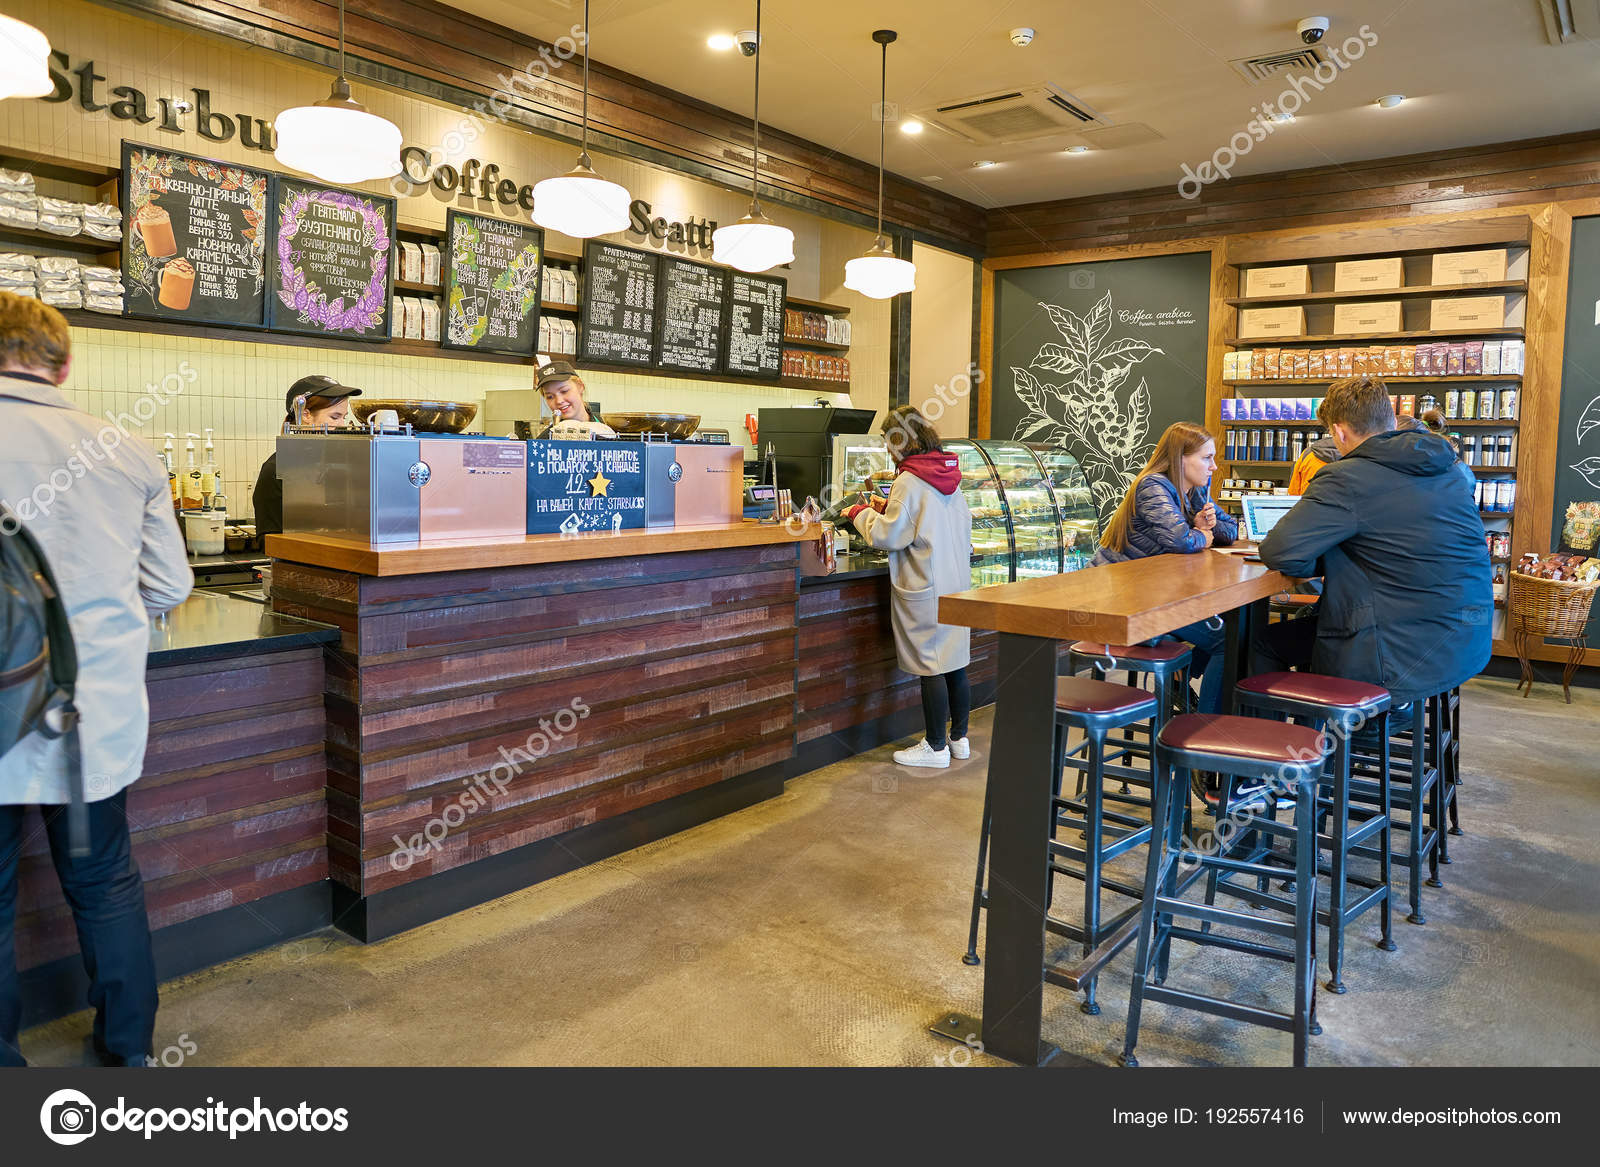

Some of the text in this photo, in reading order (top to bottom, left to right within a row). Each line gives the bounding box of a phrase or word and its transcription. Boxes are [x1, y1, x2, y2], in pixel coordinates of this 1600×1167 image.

[190, 195, 220, 211] ЛАТТЕ
[400, 146, 534, 210] Coffee
[629, 199, 718, 250] Seattl
[215, 211, 230, 221] 300
[217, 219, 232, 231] 315
[473, 217, 523, 239] ЛИМОНАДЫ
[189, 226, 234, 241] ВЕНТИ 330
[198, 237, 241, 256] НОВИНКА
[489, 245, 504, 258] АЙС
[506, 248, 517, 261] ТИ
[196, 261, 248, 279] ПЕКАН ЛАТТЕ
[476, 254, 508, 270] ЛИМОНАД
[1117, 307, 1193, 325] Coffea arabica
[547, 449, 639, 462] МЫ ДАРИМ НАПИТОК
[538, 461, 641, 474] В ПОДАРОК ЗА КАЖДЫЕ
[565, 473, 587, 495] 12
[536, 500, 548, 513] НА
[550, 496, 574, 512] ВАШЕЙ
[578, 498, 604, 511] КАРТЕ
